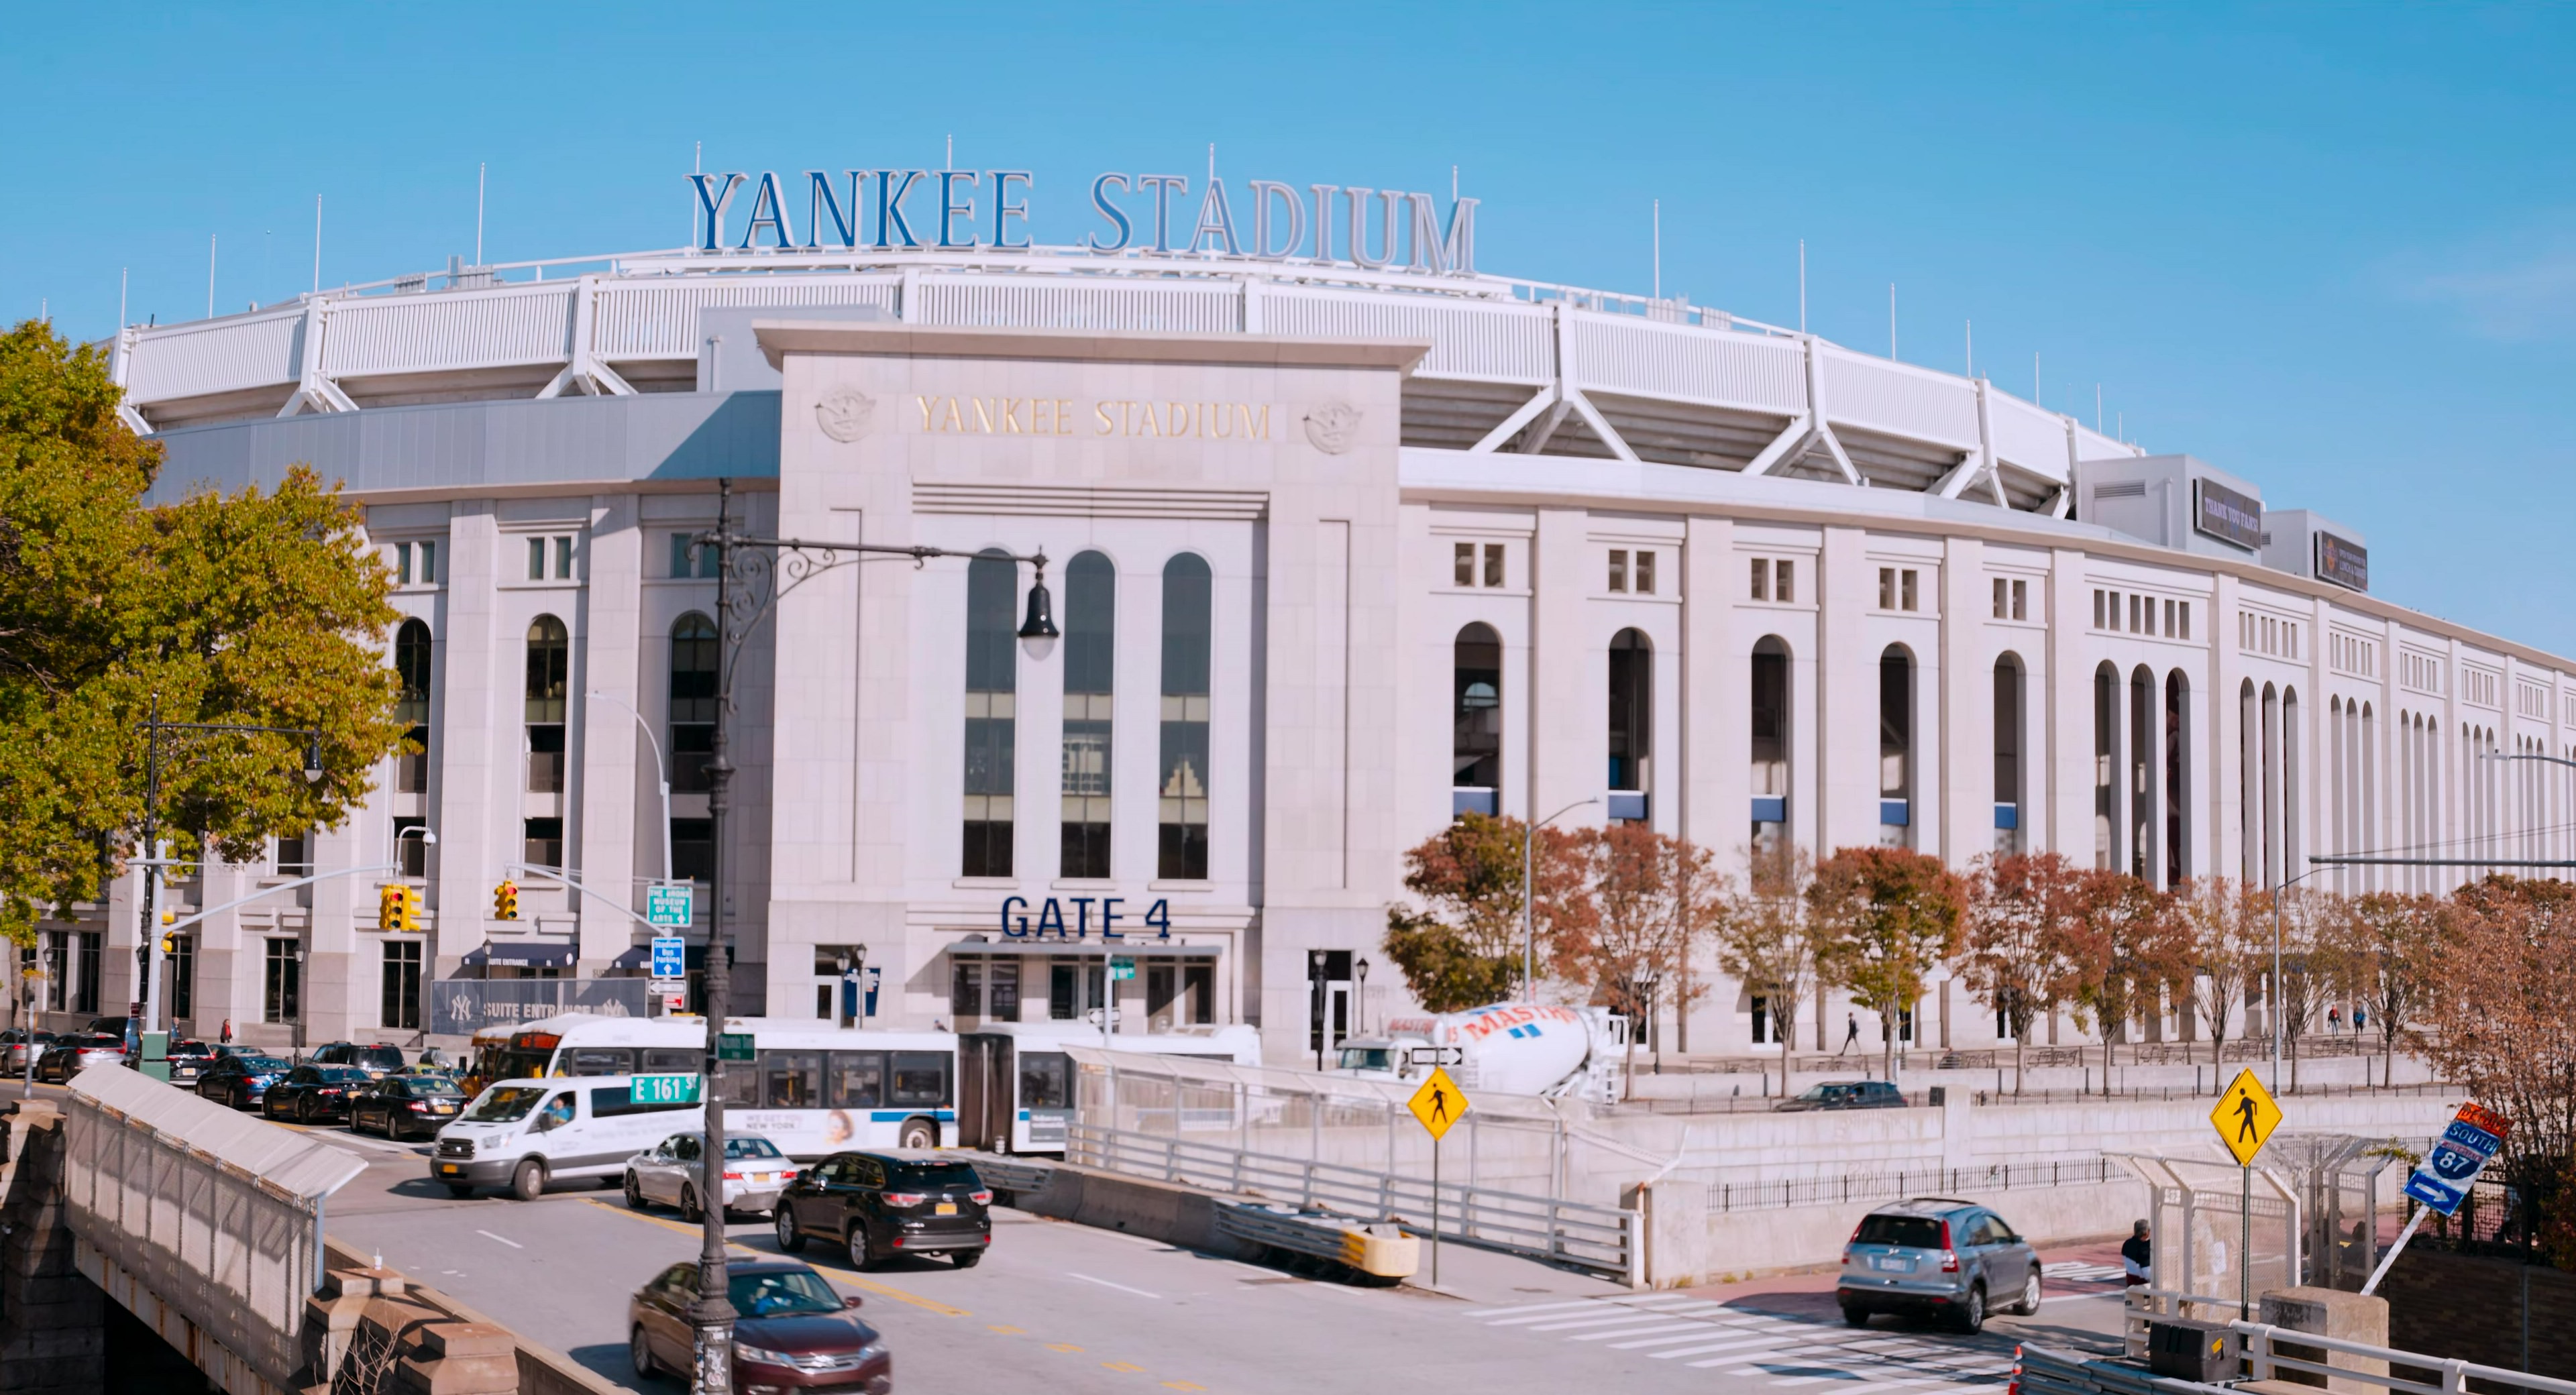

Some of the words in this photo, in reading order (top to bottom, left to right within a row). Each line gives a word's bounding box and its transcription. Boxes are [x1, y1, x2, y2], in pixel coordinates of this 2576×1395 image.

[682, 170, 1034, 253] YANKEE
[1088, 172, 1481, 278] STADIUM
[916, 396, 1073, 435] YANKEE
[1095, 400, 1271, 440] STADIUM
[2204, 496, 2227, 520] THANK
[2227, 506, 2241, 525] YOU
[653, 897, 686, 905] MUSEUM
[653, 914, 673, 922] ARTS
[1002, 895, 1124, 938] GATE
[1144, 898, 1171, 938] 4
[655, 956, 681, 965] Parking
[484, 1003, 519, 1017] SUITE
[636, 1078, 645, 1101] E
[652, 1078, 681, 1101] 161
[2450, 1125, 2495, 1152] SOUTH
[2439, 1152, 2470, 1172] 87
